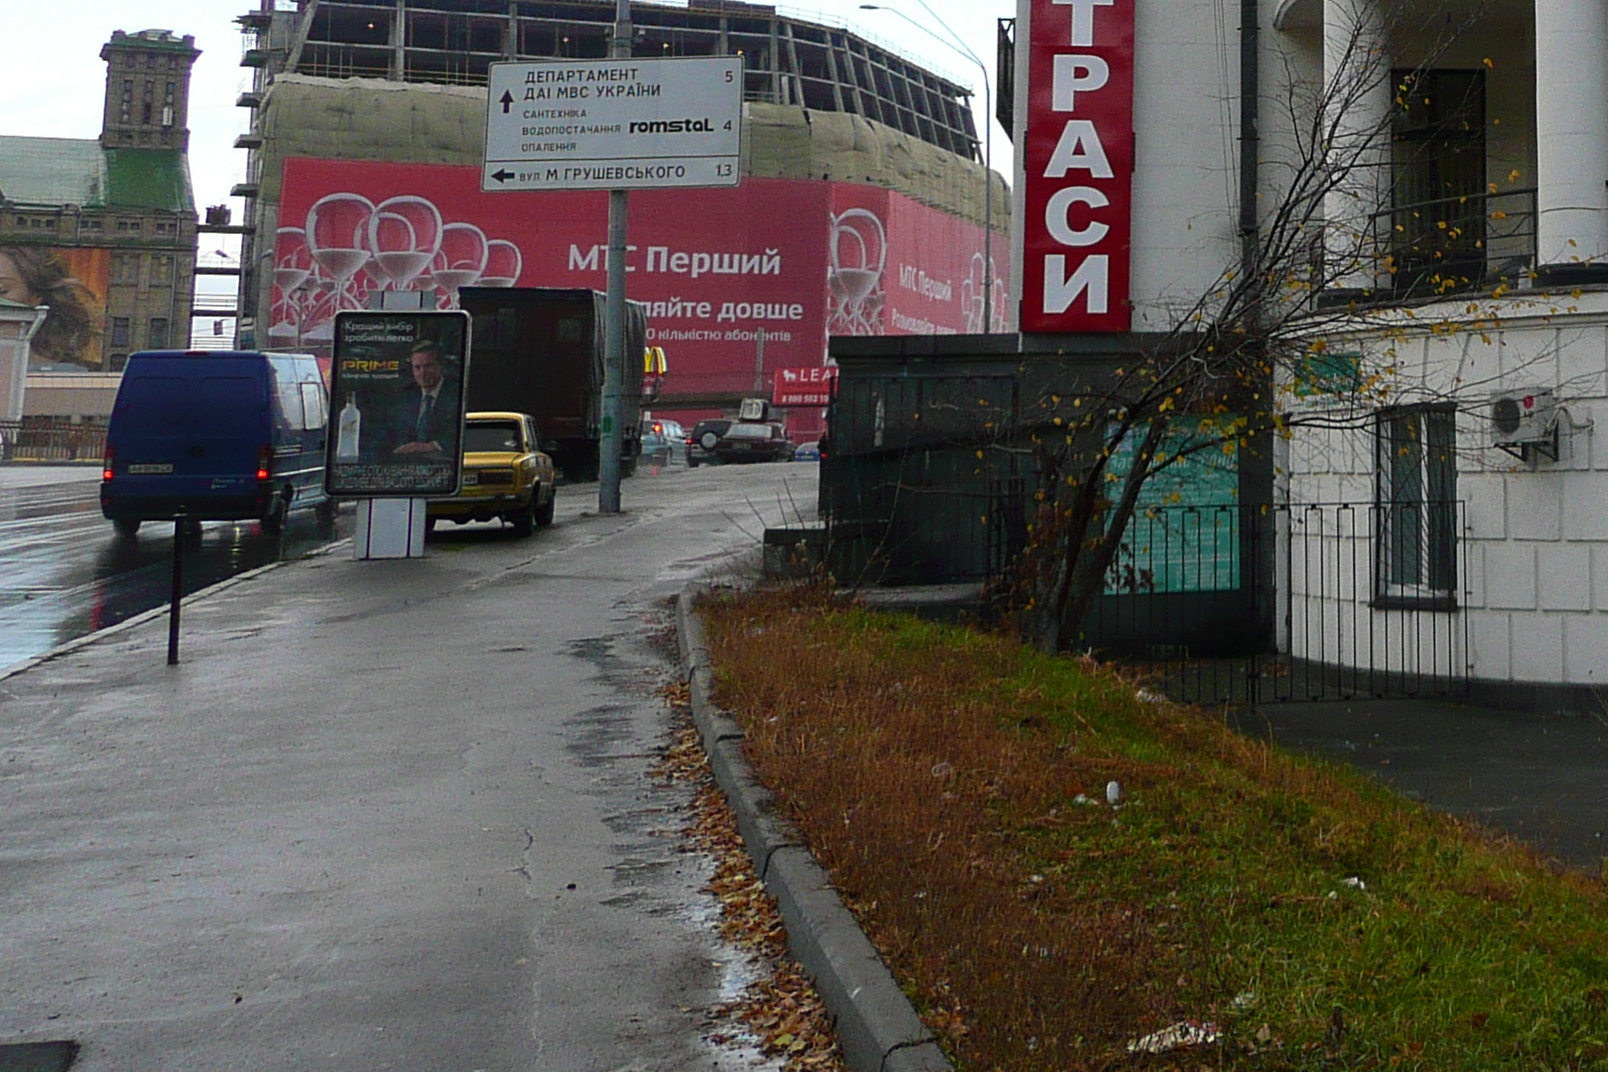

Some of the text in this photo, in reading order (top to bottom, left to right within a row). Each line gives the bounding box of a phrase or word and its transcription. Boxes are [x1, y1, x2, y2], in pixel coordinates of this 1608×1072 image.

[525, 68, 638, 84] ДЕПАРТАМЕНТ
[725, 70, 733, 83] 5
[524, 83, 661, 101] ДАІ МВС УКРАЇНИ
[523, 109, 587, 119] САНТЕХНІКА
[522, 124, 621, 136] ВОДОПОСТАЧАННЯ
[723, 120, 732, 132] 4
[521, 142, 577, 153] ОПАЛЕННЯ
[564, 165, 685, 181] ГРУШЕВСЬКОГО
[646, 246, 780, 278] Перший
[717, 302, 803, 323] довше
[724, 329, 791, 342] абоннтів
[342, 359, 399, 372] PRIME
